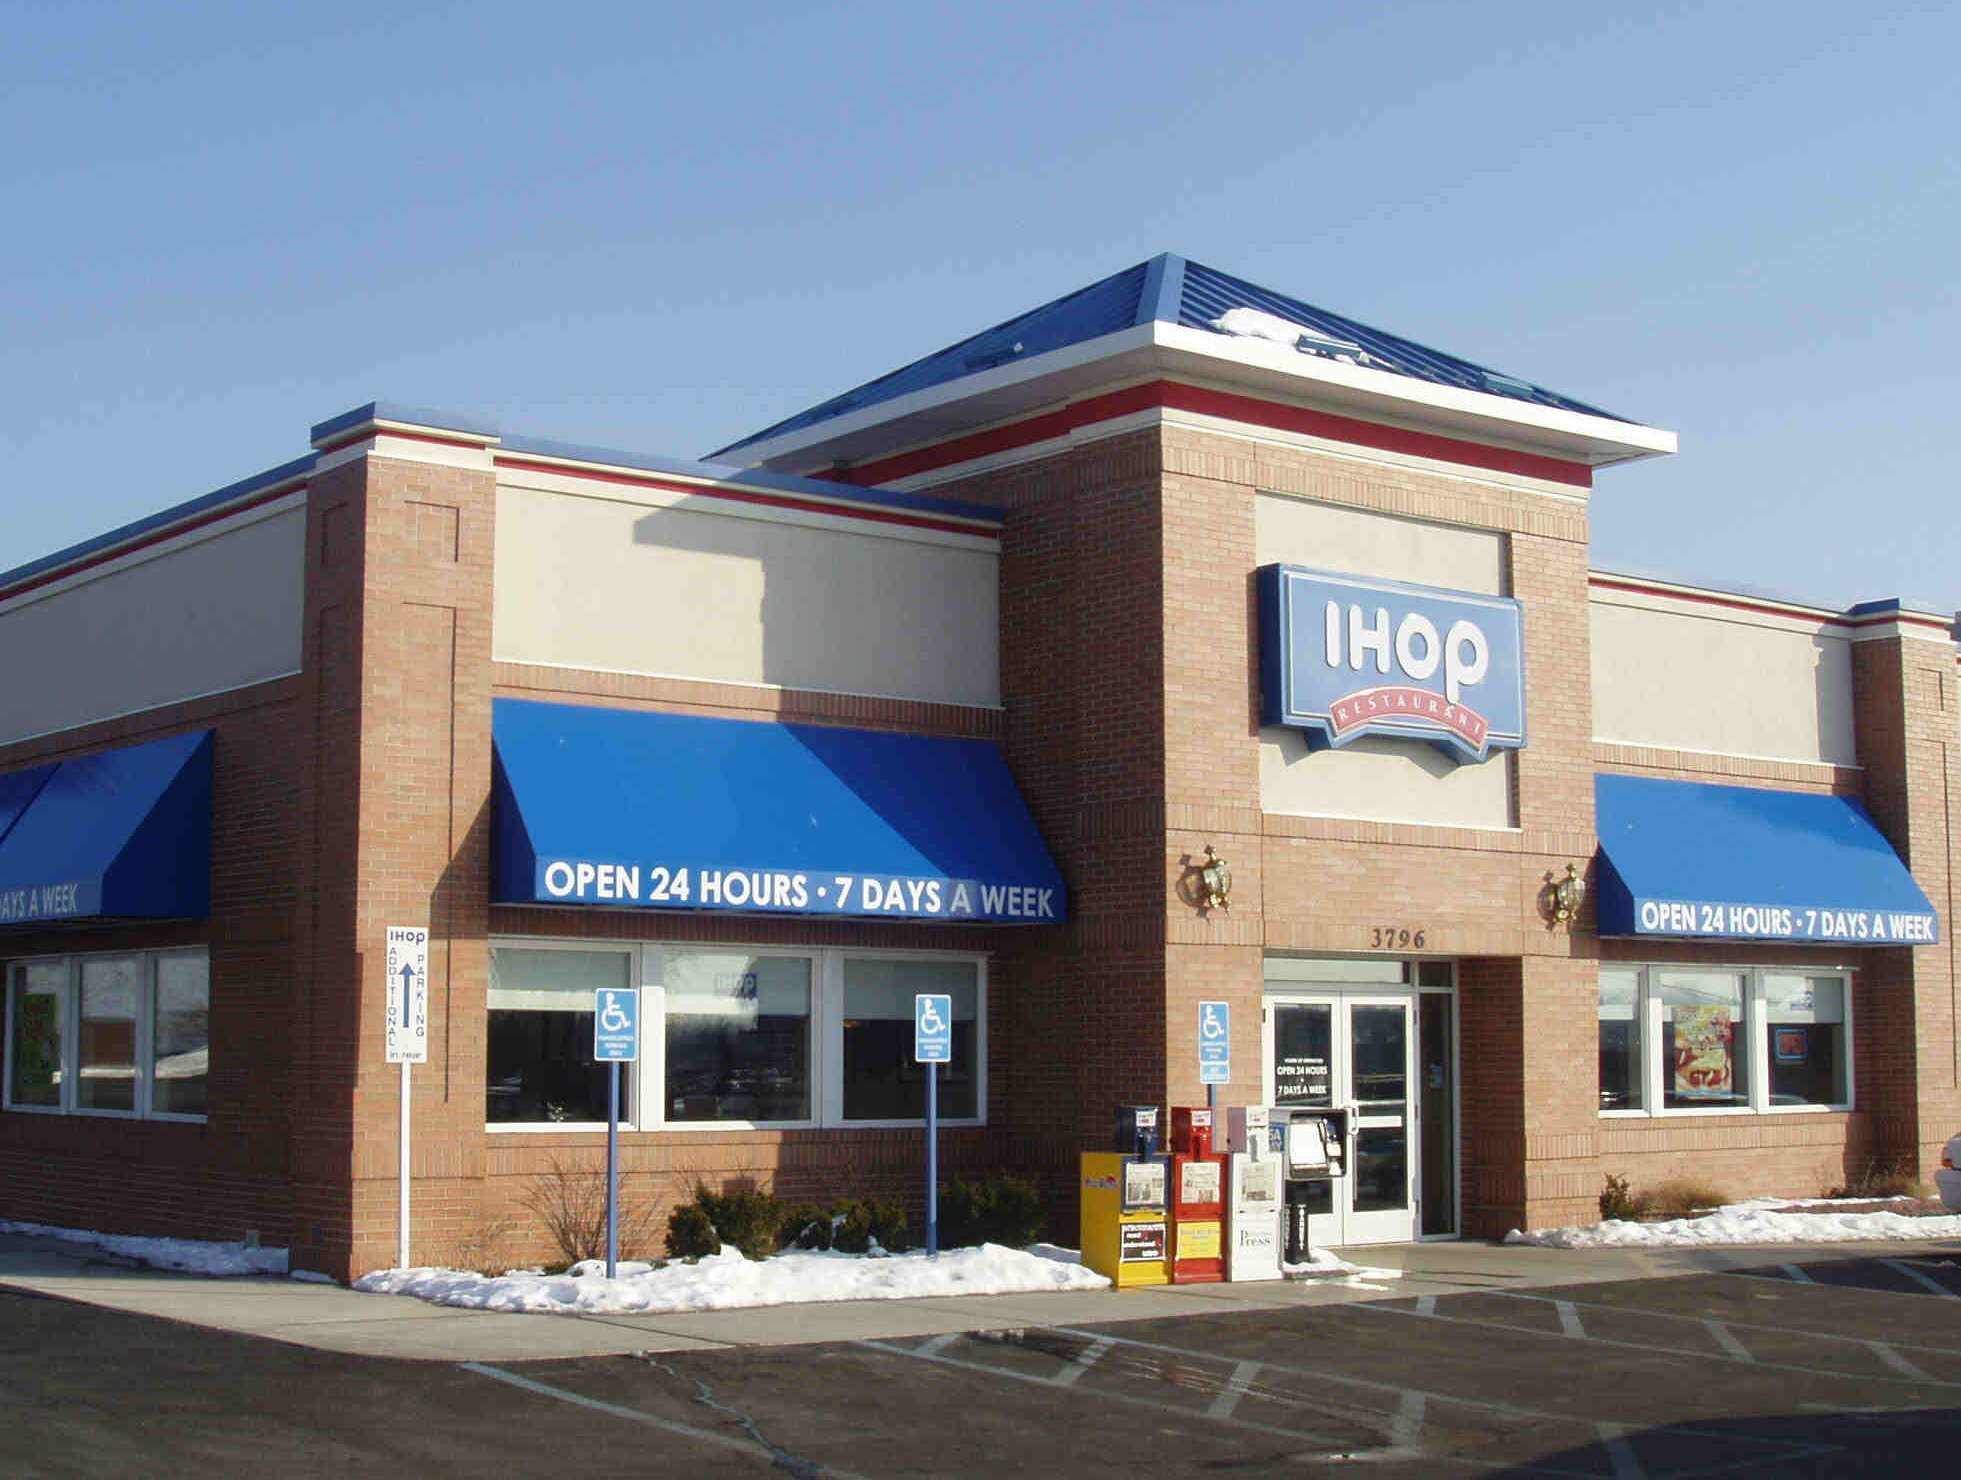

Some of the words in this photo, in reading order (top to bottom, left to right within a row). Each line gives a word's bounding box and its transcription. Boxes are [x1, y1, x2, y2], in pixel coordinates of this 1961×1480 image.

[1326, 600, 1488, 704] IHOP
[1337, 694, 1482, 733] RESTAURANT
[0, 891, 25, 920] AYS
[28, 888, 39, 918] A
[42, 883, 79, 916] WEEK
[545, 861, 640, 900] OPEN
[650, 867, 690, 901] 24
[700, 870, 808, 908] HOURS
[834, 876, 853, 909] 7
[862, 878, 942, 914] DAYS
[951, 883, 973, 914] A
[980, 883, 1054, 918] WEEK
[1371, 928, 1425, 949] 3796
[1641, 902, 1696, 931] OPEN
[1701, 905, 1725, 932] 24
[1729, 906, 1792, 936] HOURS
[1806, 911, 1816, 936] 7
[1821, 911, 1867, 938] DAYS
[1872, 914, 1887, 938] A
[1888, 914, 1934, 941] WEEK
[387, 946, 398, 1047] ADDITIONAL
[415, 954, 425, 1038] PARKING
[1240, 1230, 1272, 1247] Press
